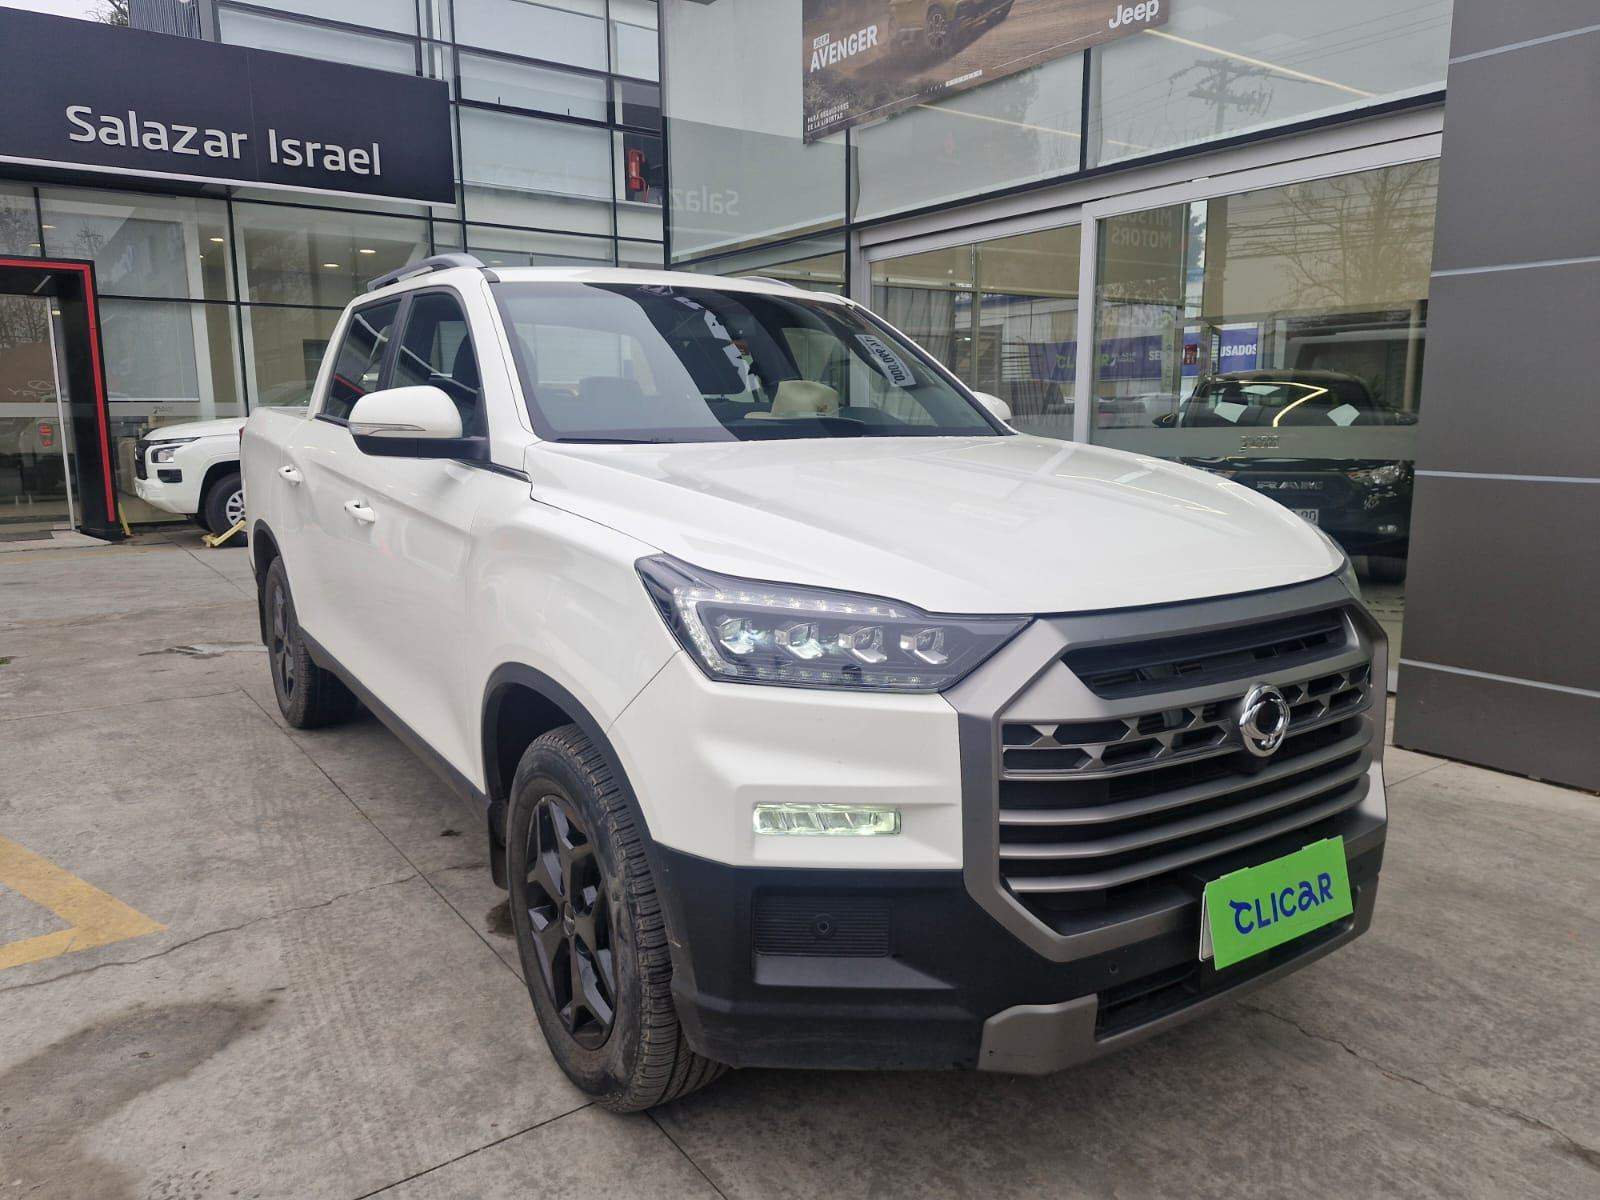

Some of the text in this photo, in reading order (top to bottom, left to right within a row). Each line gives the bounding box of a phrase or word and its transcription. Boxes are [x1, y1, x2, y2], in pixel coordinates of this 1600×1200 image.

[1108, 0, 1159, 29] Jeep
[810, 25, 878, 73] AVENGER
[65, 105, 381, 176] Salazar Israel
